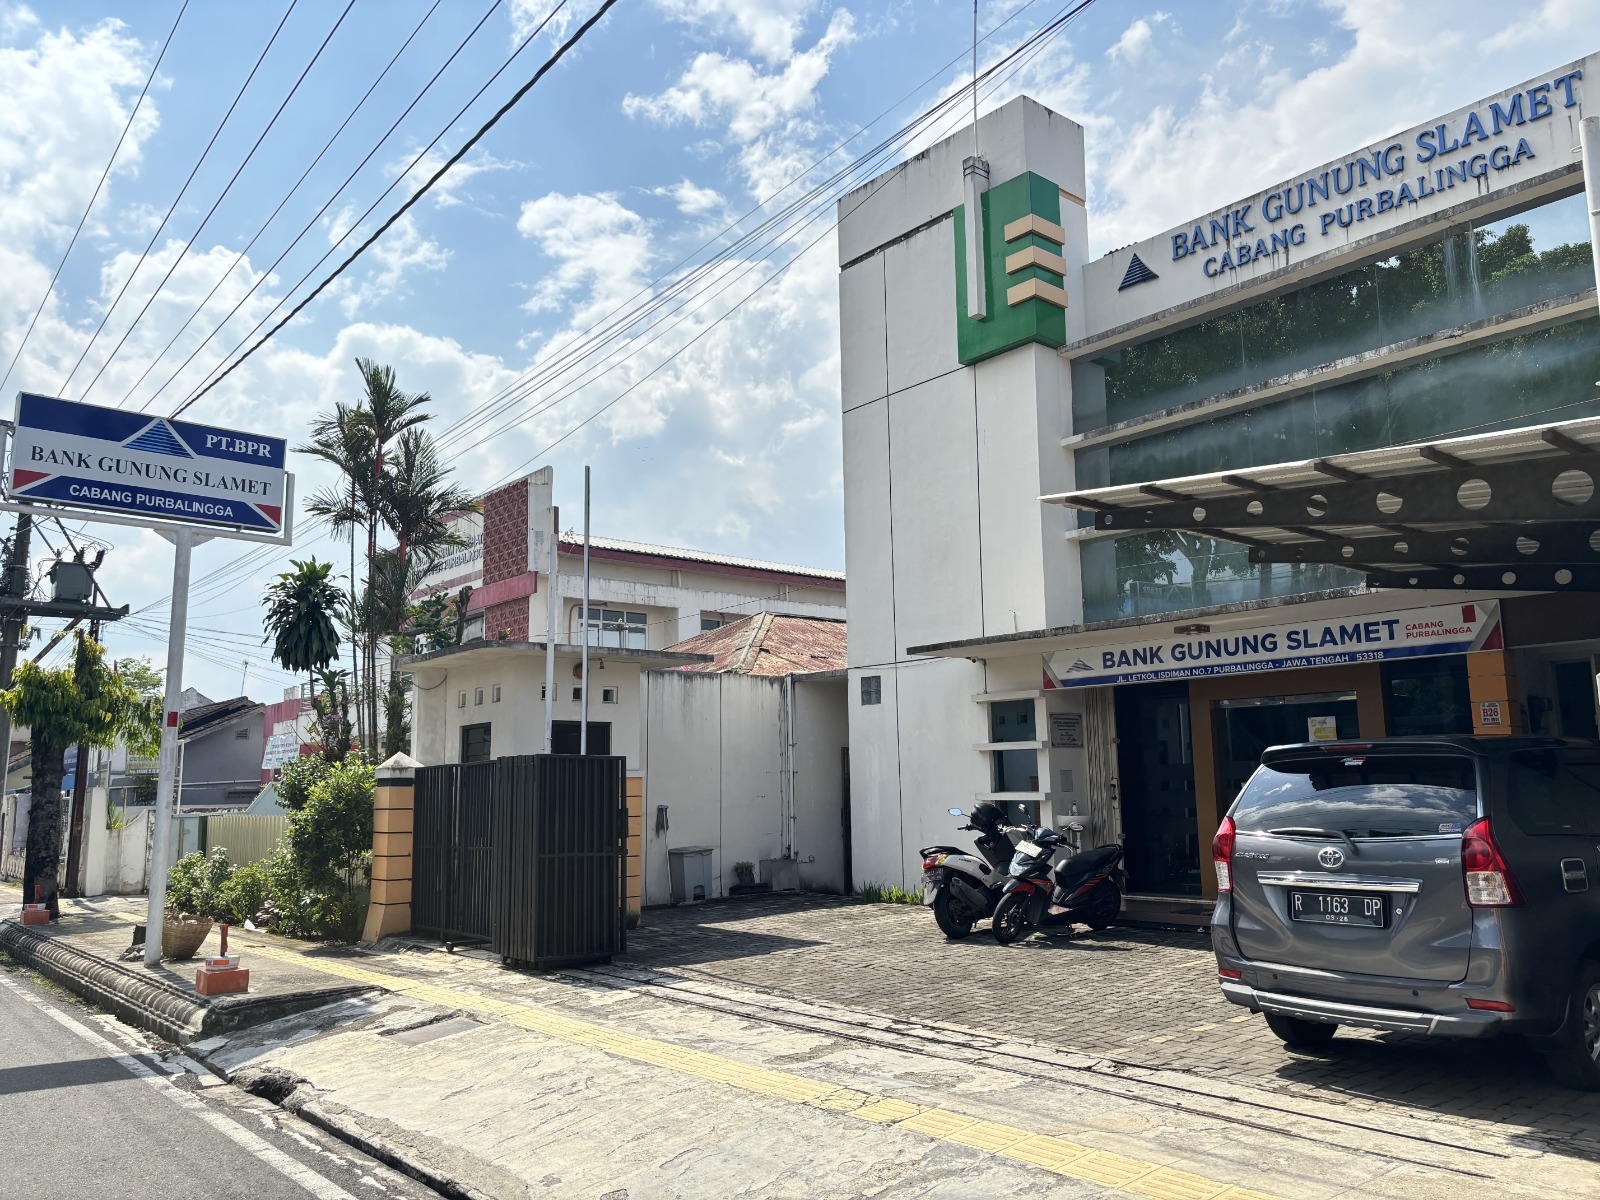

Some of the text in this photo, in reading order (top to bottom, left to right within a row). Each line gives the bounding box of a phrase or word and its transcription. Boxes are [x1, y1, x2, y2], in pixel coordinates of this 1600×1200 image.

[1171, 69, 1583, 262] BANK GUNUNG SLAMET
[1203, 137, 1536, 278] CABANG PURBALINGGA
[205, 433, 272, 458] PT.BPR
[31, 444, 272, 496] BANK GUNUNG SLAMET
[69, 484, 234, 518] CABANG PURBALINGGA
[1405, 620, 1444, 631] CABANG
[1405, 627, 1473, 639] PURBALINGGA
[1102, 618, 1400, 670] BANK GUNUNG SLAMET
[1116, 674, 1127, 683] JL.
[1128, 672, 1157, 682] LETKOL
[1158, 669, 1191, 679] ISDIMAN
[1192, 666, 1211, 676] NO.7
[1213, 661, 1274, 674] PURBALINGGA
[1281, 658, 1308, 668] JAWA
[1309, 654, 1349, 664] TENGAH
[1356, 651, 1384, 661] 53318
[1482, 708, 1499, 718] B26
[1294, 894, 1381, 916] R 1163 DP
